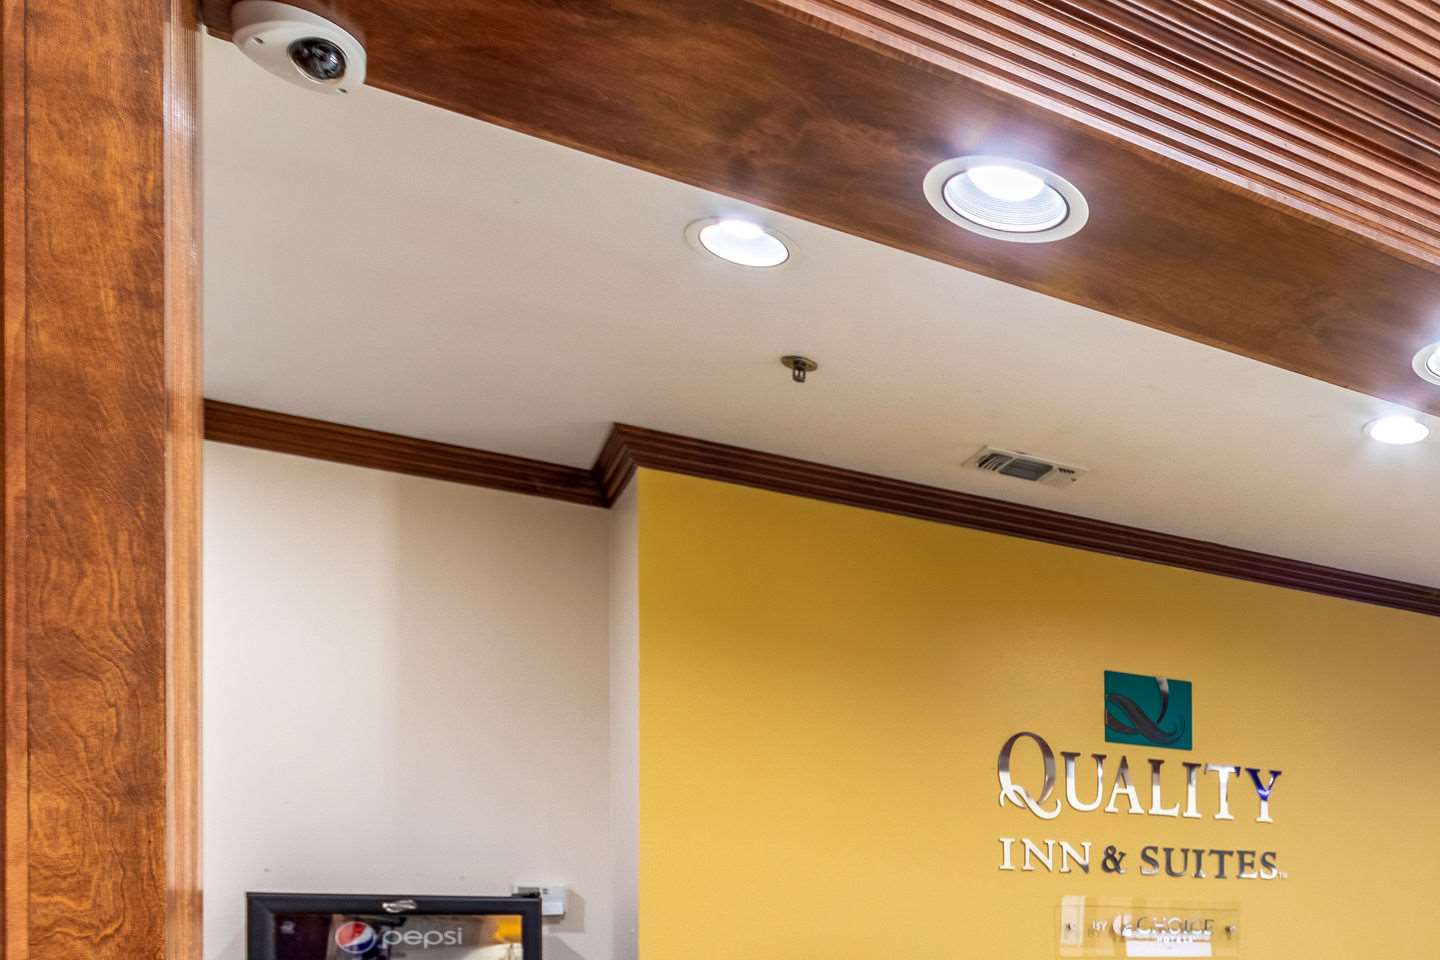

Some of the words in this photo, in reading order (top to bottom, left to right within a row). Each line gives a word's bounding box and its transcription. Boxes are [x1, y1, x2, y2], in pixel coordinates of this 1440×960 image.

[998, 731, 1282, 823] QUALITY
[999, 837, 1092, 874] INN
[1102, 845, 1127, 875] &
[1139, 845, 1279, 880] SUITES
[381, 927, 463, 949] pepsi
[1136, 916, 1215, 936] CHOICE
